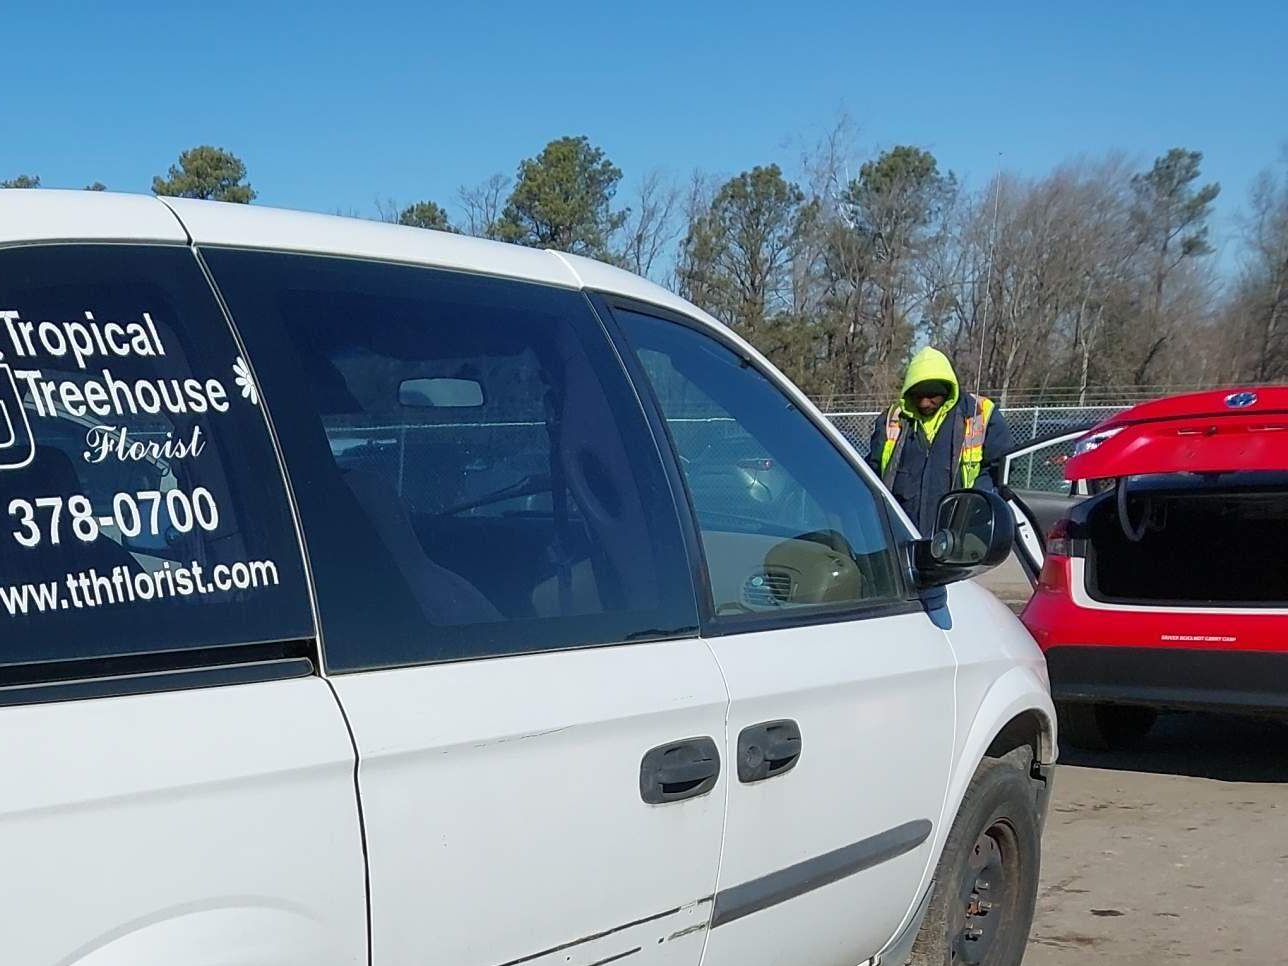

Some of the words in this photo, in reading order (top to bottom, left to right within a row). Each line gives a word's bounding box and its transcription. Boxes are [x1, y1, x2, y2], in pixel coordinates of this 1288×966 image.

[15, 369, 230, 417] Treehouse
[83, 425, 206, 463] Florist
[8, 487, 219, 547] 378-0700
